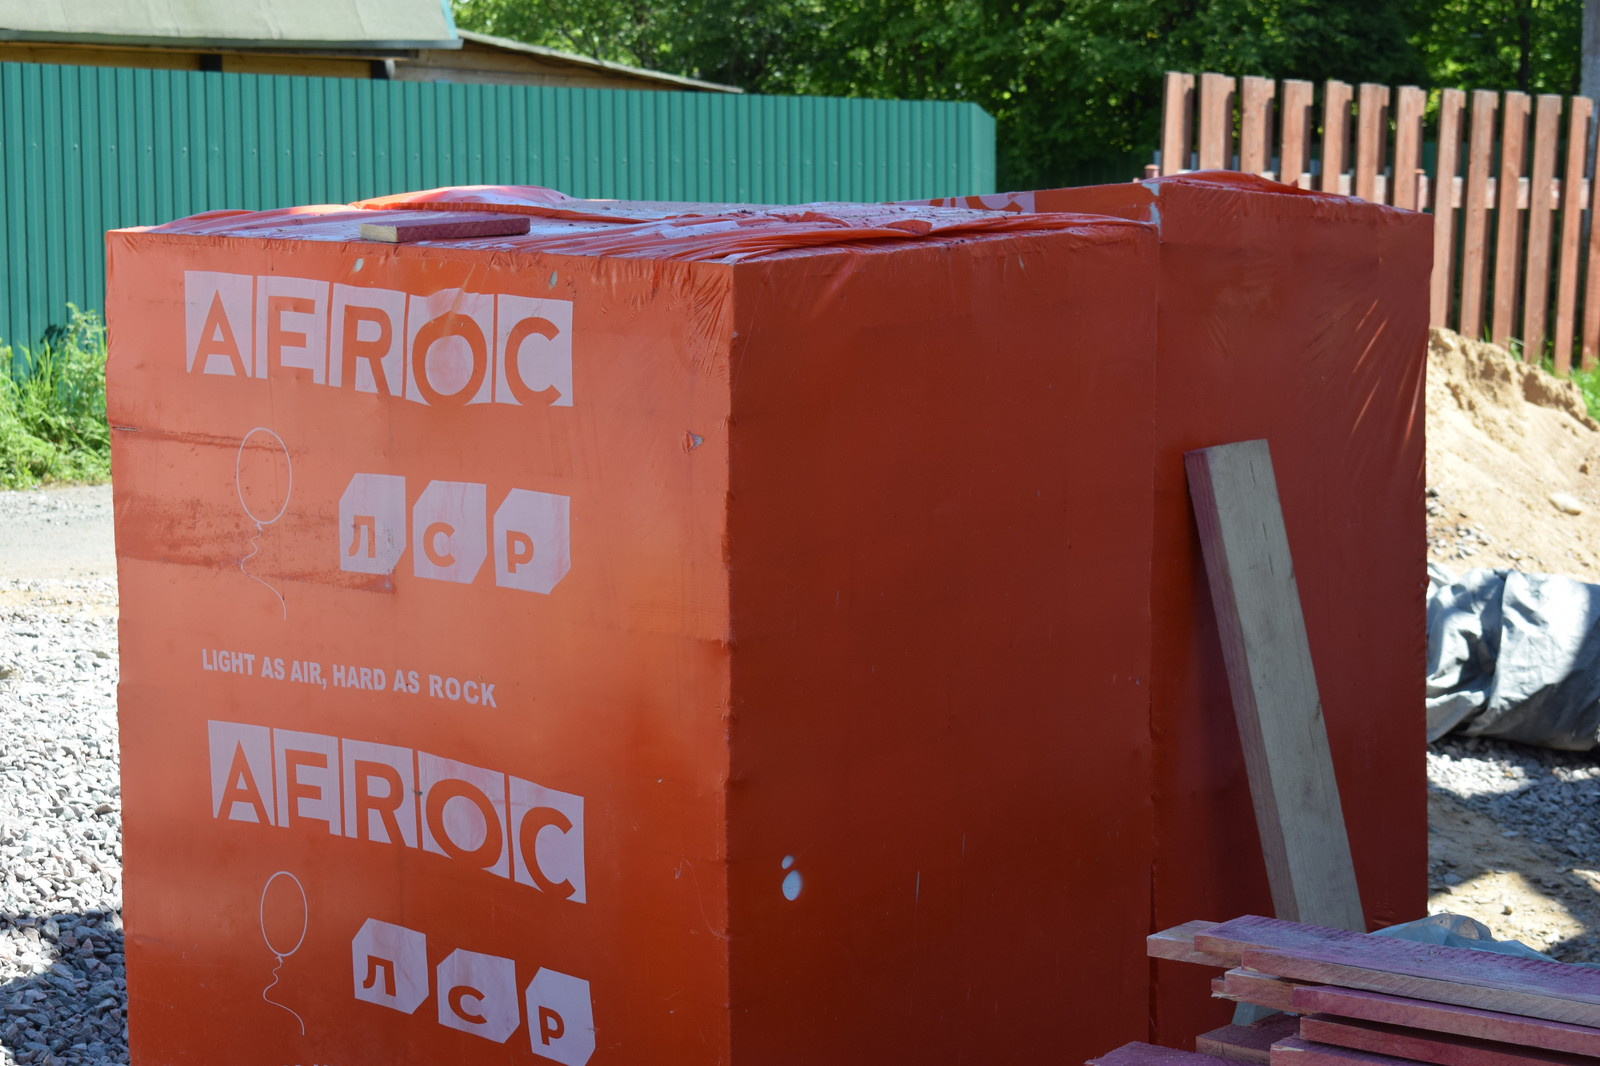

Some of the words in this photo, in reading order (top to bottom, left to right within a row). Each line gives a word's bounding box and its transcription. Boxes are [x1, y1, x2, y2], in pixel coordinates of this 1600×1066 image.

[188, 288, 564, 407] AEROC
[202, 648, 255, 676] LIGHT
[261, 656, 286, 680] AS
[290, 660, 328, 690] AIR,
[332, 664, 386, 691] HARD
[393, 669, 420, 694] AS
[428, 674, 497, 708] ROCK
[216, 738, 578, 900] AEROC
[362, 953, 566, 1046] ЛСР
